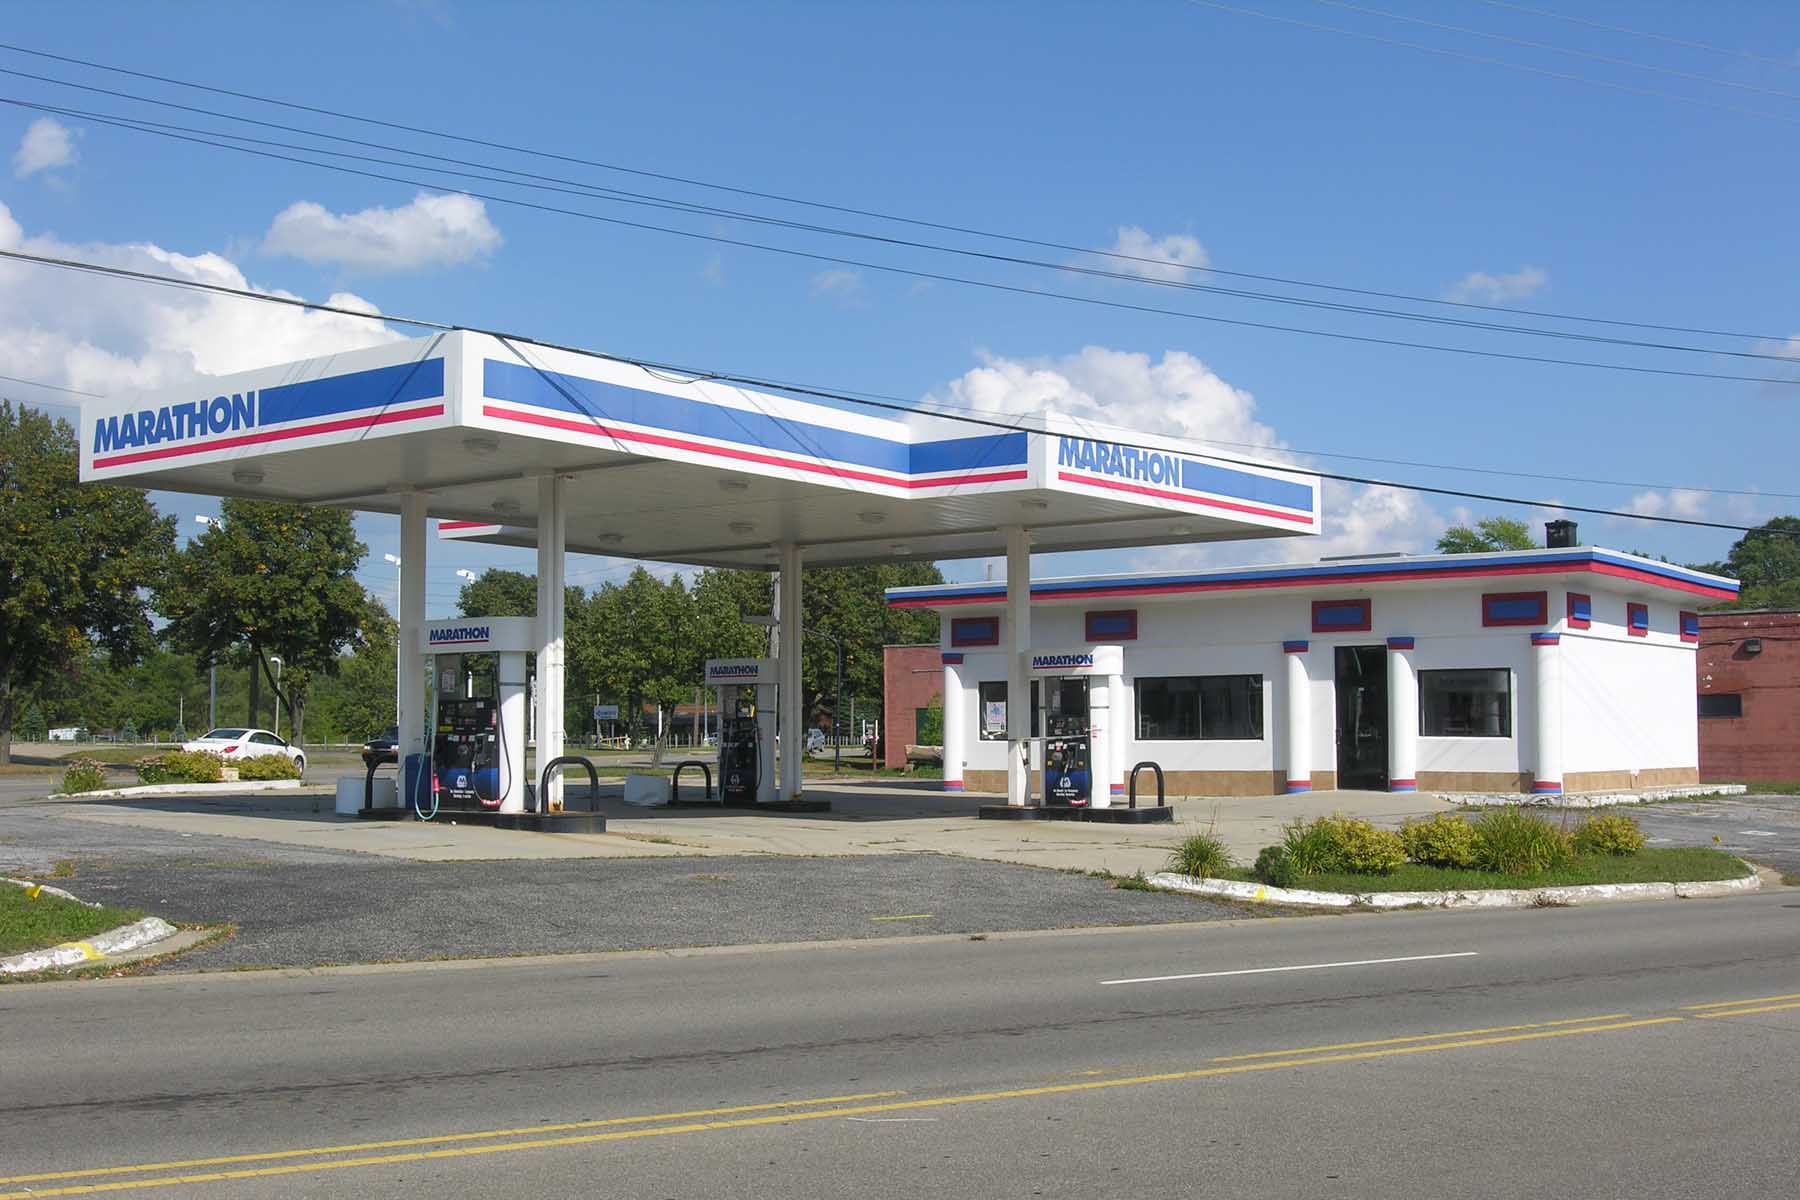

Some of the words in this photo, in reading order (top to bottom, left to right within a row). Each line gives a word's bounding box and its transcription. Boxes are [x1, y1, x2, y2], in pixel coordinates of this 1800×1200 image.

[94, 391, 255, 453] MARATHON
[1058, 437, 1180, 487] MARATHON
[430, 626, 489, 641] MARATHON
[1033, 654, 1093, 666] MARATHON
[710, 665, 758, 675] MARATHON
